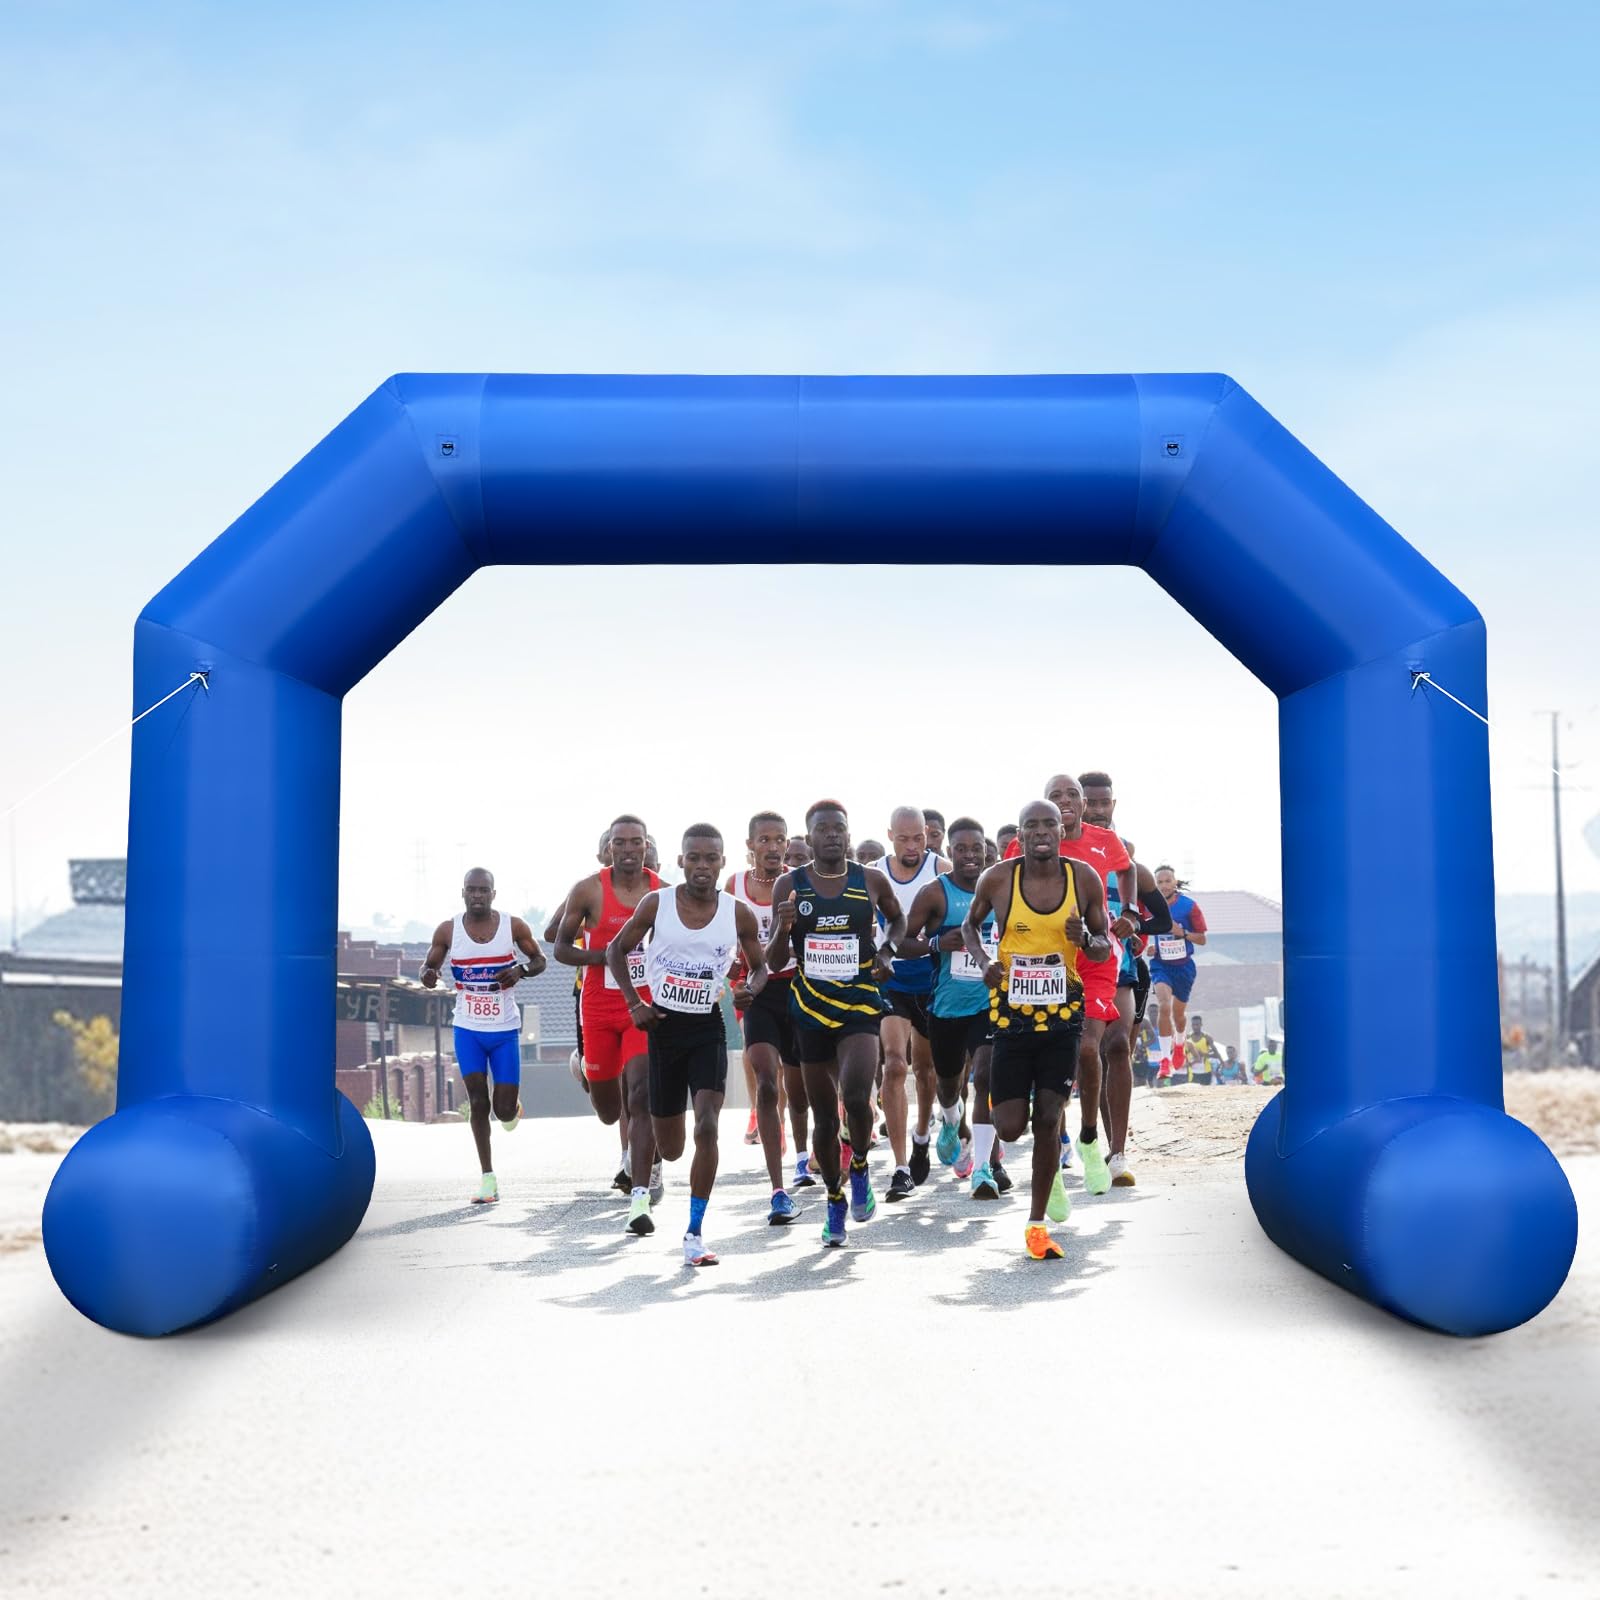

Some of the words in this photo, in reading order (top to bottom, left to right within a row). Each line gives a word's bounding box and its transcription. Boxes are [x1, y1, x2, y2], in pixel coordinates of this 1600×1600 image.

[806, 952, 857, 964] MAYIBONGWE
[673, 979, 703, 988] SPAR
[1012, 978, 1064, 995] PHILANI
[661, 983, 712, 1005] SAMUEL
[467, 1002, 500, 1016] 1885
